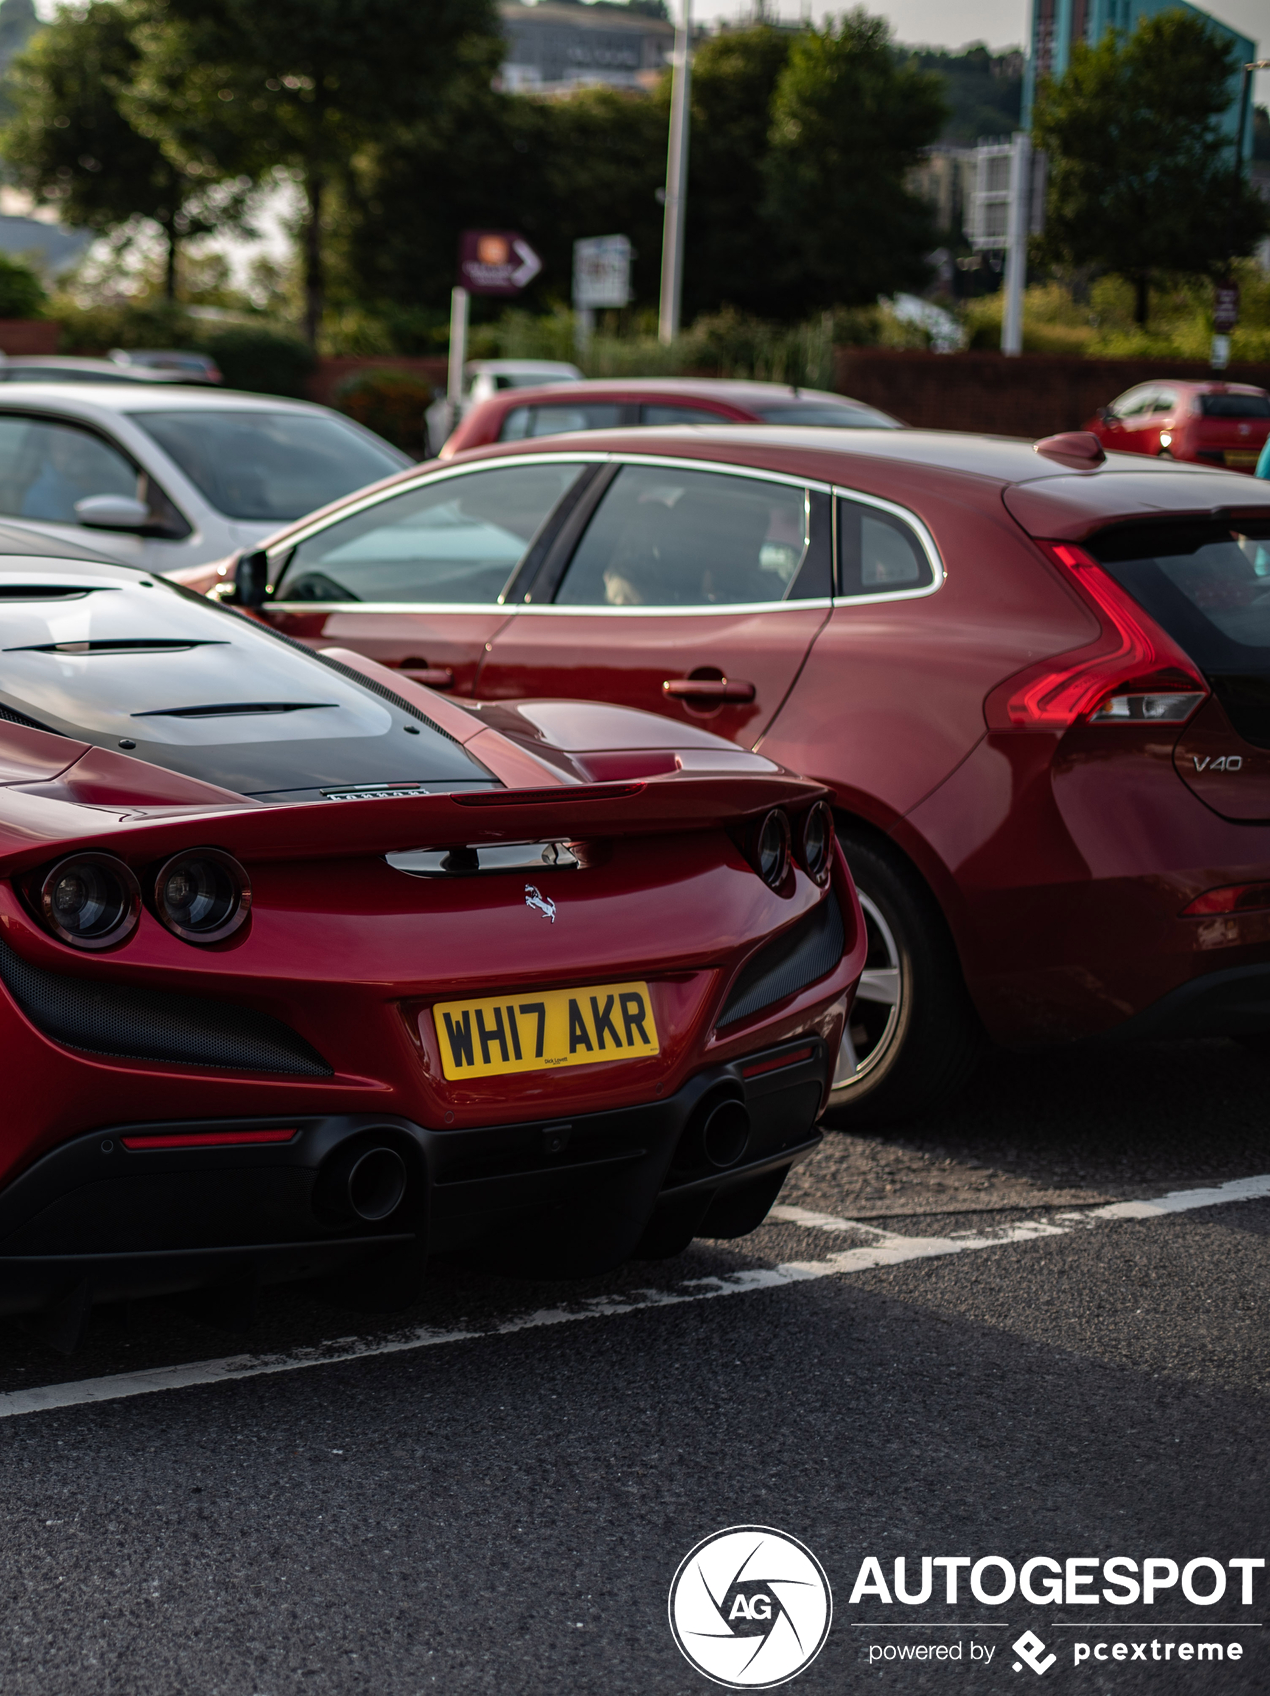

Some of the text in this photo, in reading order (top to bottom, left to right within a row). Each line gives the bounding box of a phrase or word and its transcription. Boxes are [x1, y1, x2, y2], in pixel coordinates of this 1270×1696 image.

[1193, 755, 1242, 772] V40
[442, 991, 651, 1068] WH17 AKR
